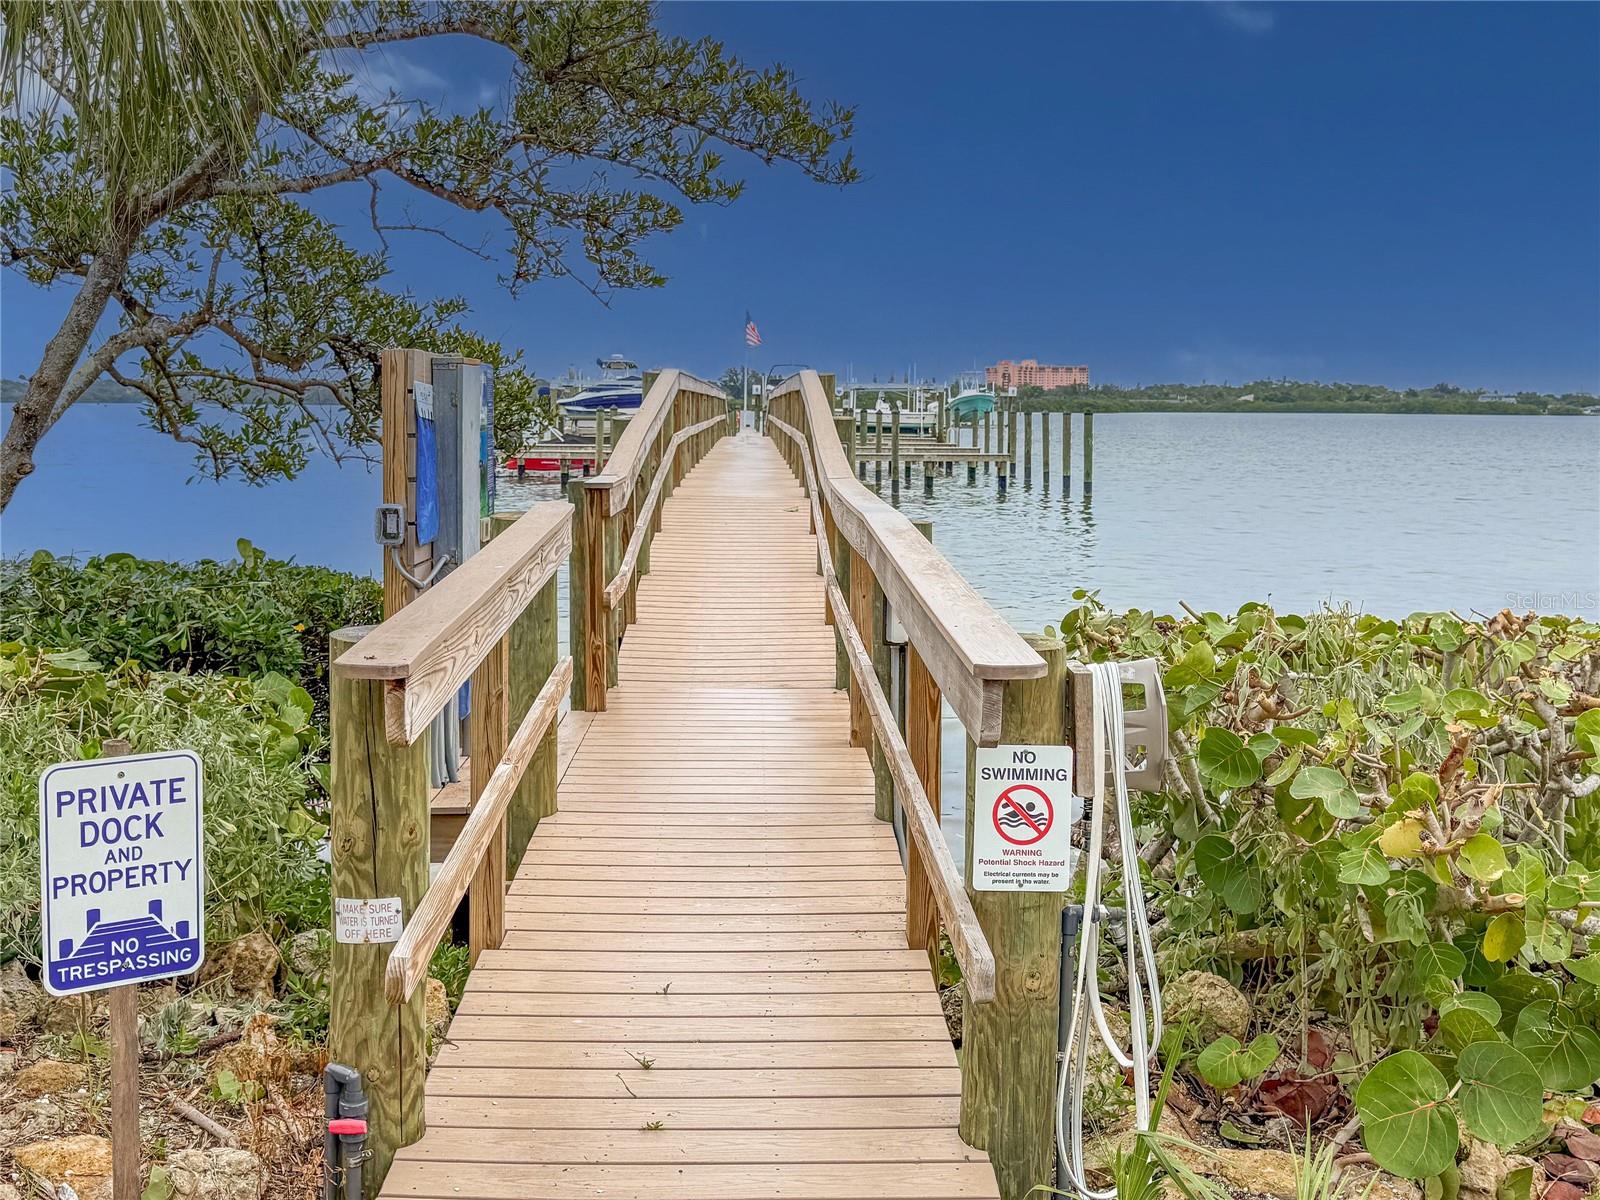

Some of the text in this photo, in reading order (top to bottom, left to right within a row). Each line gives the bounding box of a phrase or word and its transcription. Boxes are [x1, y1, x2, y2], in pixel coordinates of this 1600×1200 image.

[1012, 751, 1037, 764] NO
[981, 767, 1068, 782] SWIMMING
[56, 777, 186, 818] PRIVATE
[80, 811, 164, 848] DOCK
[104, 846, 143, 865] AND
[1002, 849, 1043, 857] WARNING
[978, 858, 1065, 867] Potential Shock Hazard
[53, 858, 192, 900] PROPERTY
[342, 903, 392, 914] MAKE SURE
[361, 917, 367, 927] IS
[370, 915, 398, 926] TURNED
[344, 928, 392, 938] OFF HERE
[111, 937, 139, 956] NO
[57, 947, 192, 983] TRESPASSING
